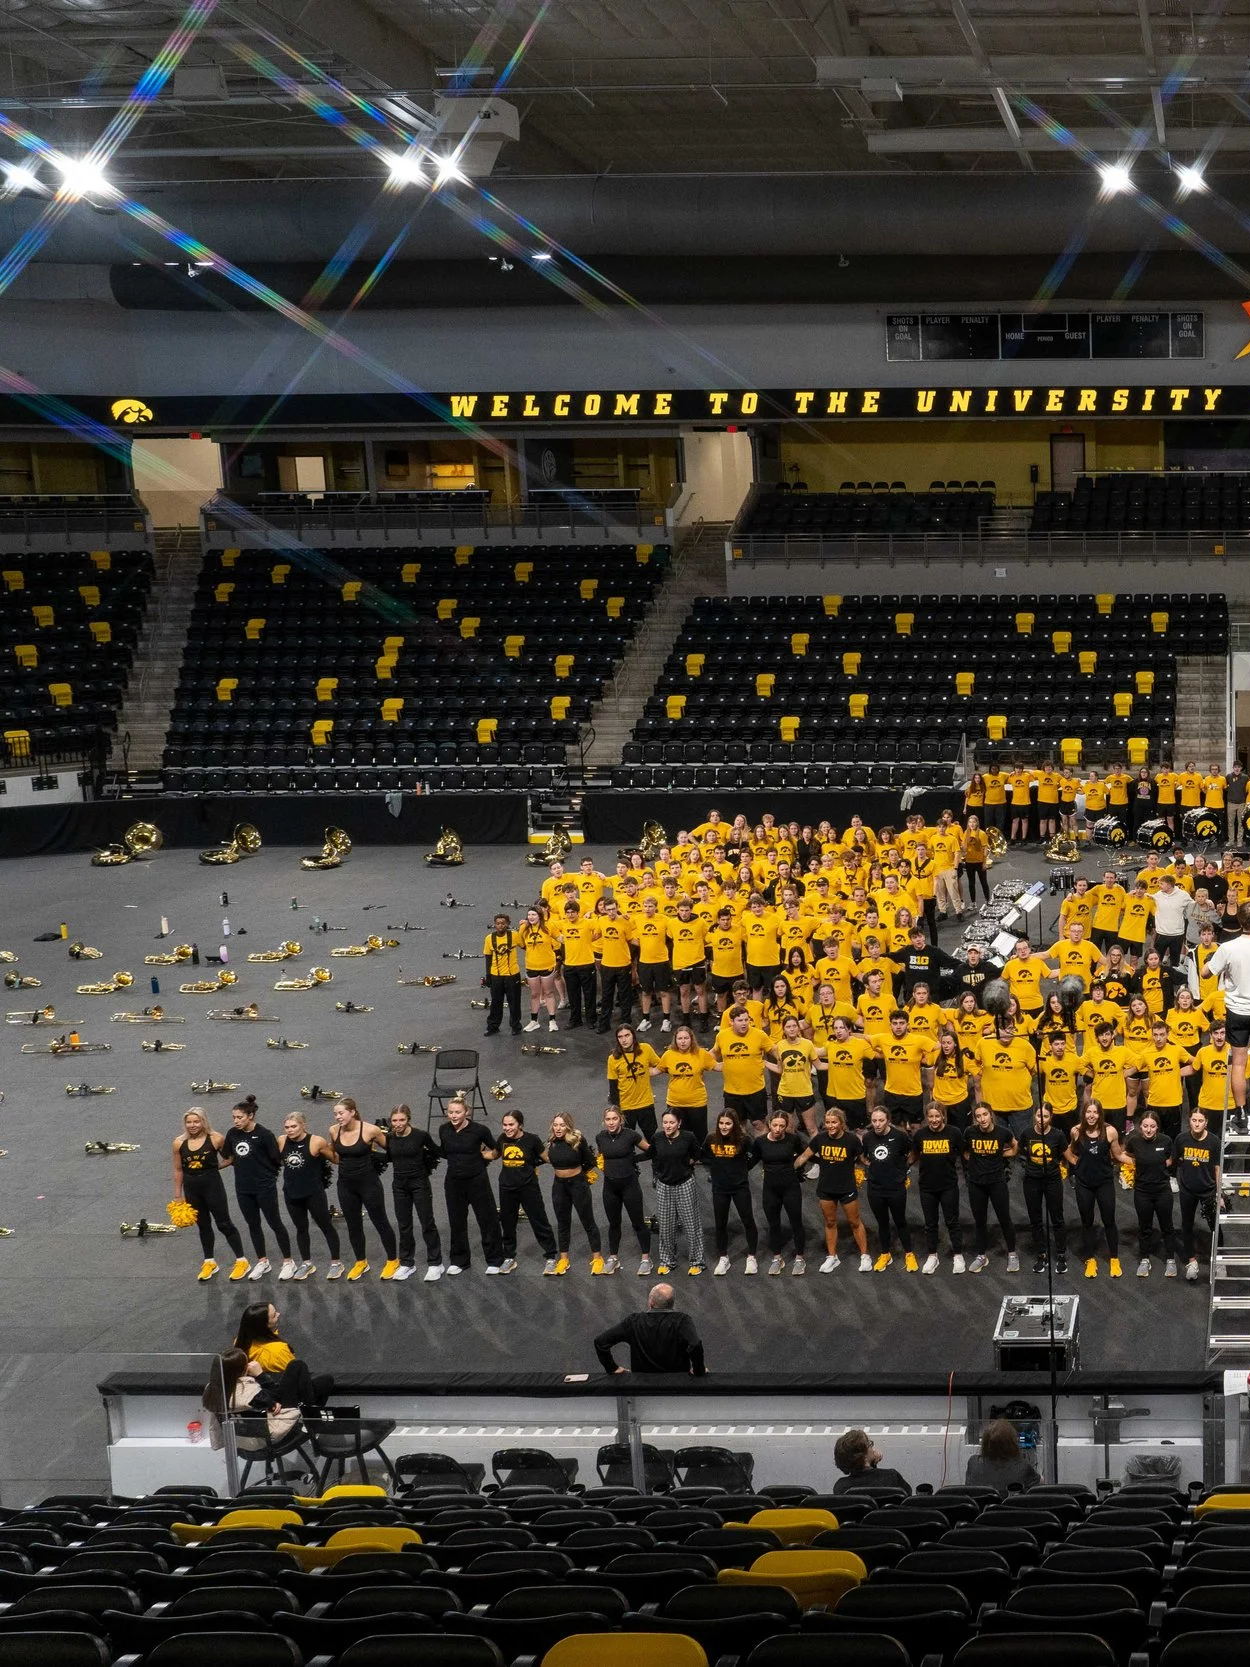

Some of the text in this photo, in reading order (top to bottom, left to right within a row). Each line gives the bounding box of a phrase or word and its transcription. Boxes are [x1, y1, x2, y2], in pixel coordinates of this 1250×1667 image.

[926, 316, 950, 324] PLAYER
[961, 316, 989, 324] PENALTY
[1096, 315, 1121, 323] PLAYER
[1131, 315, 1159, 323] PENALTY
[1183, 322, 1193, 330] ON
[895, 332, 912, 340] GOAL
[1005, 332, 1025, 340] HOME
[1064, 332, 1087, 340] GUEST
[1178, 330, 1196, 338] GOAL
[450, 393, 673, 417] WELCOME
[709, 392, 759, 414] TO
[794, 391, 879, 414] THE
[916, 388, 1222, 413] UNIVERSITY
[923, 1139, 950, 1149] IOWA
[971, 1139, 999, 1150] IOWA
[821, 1145, 848, 1158] IOWA
[1184, 1147, 1210, 1159] IOWA
